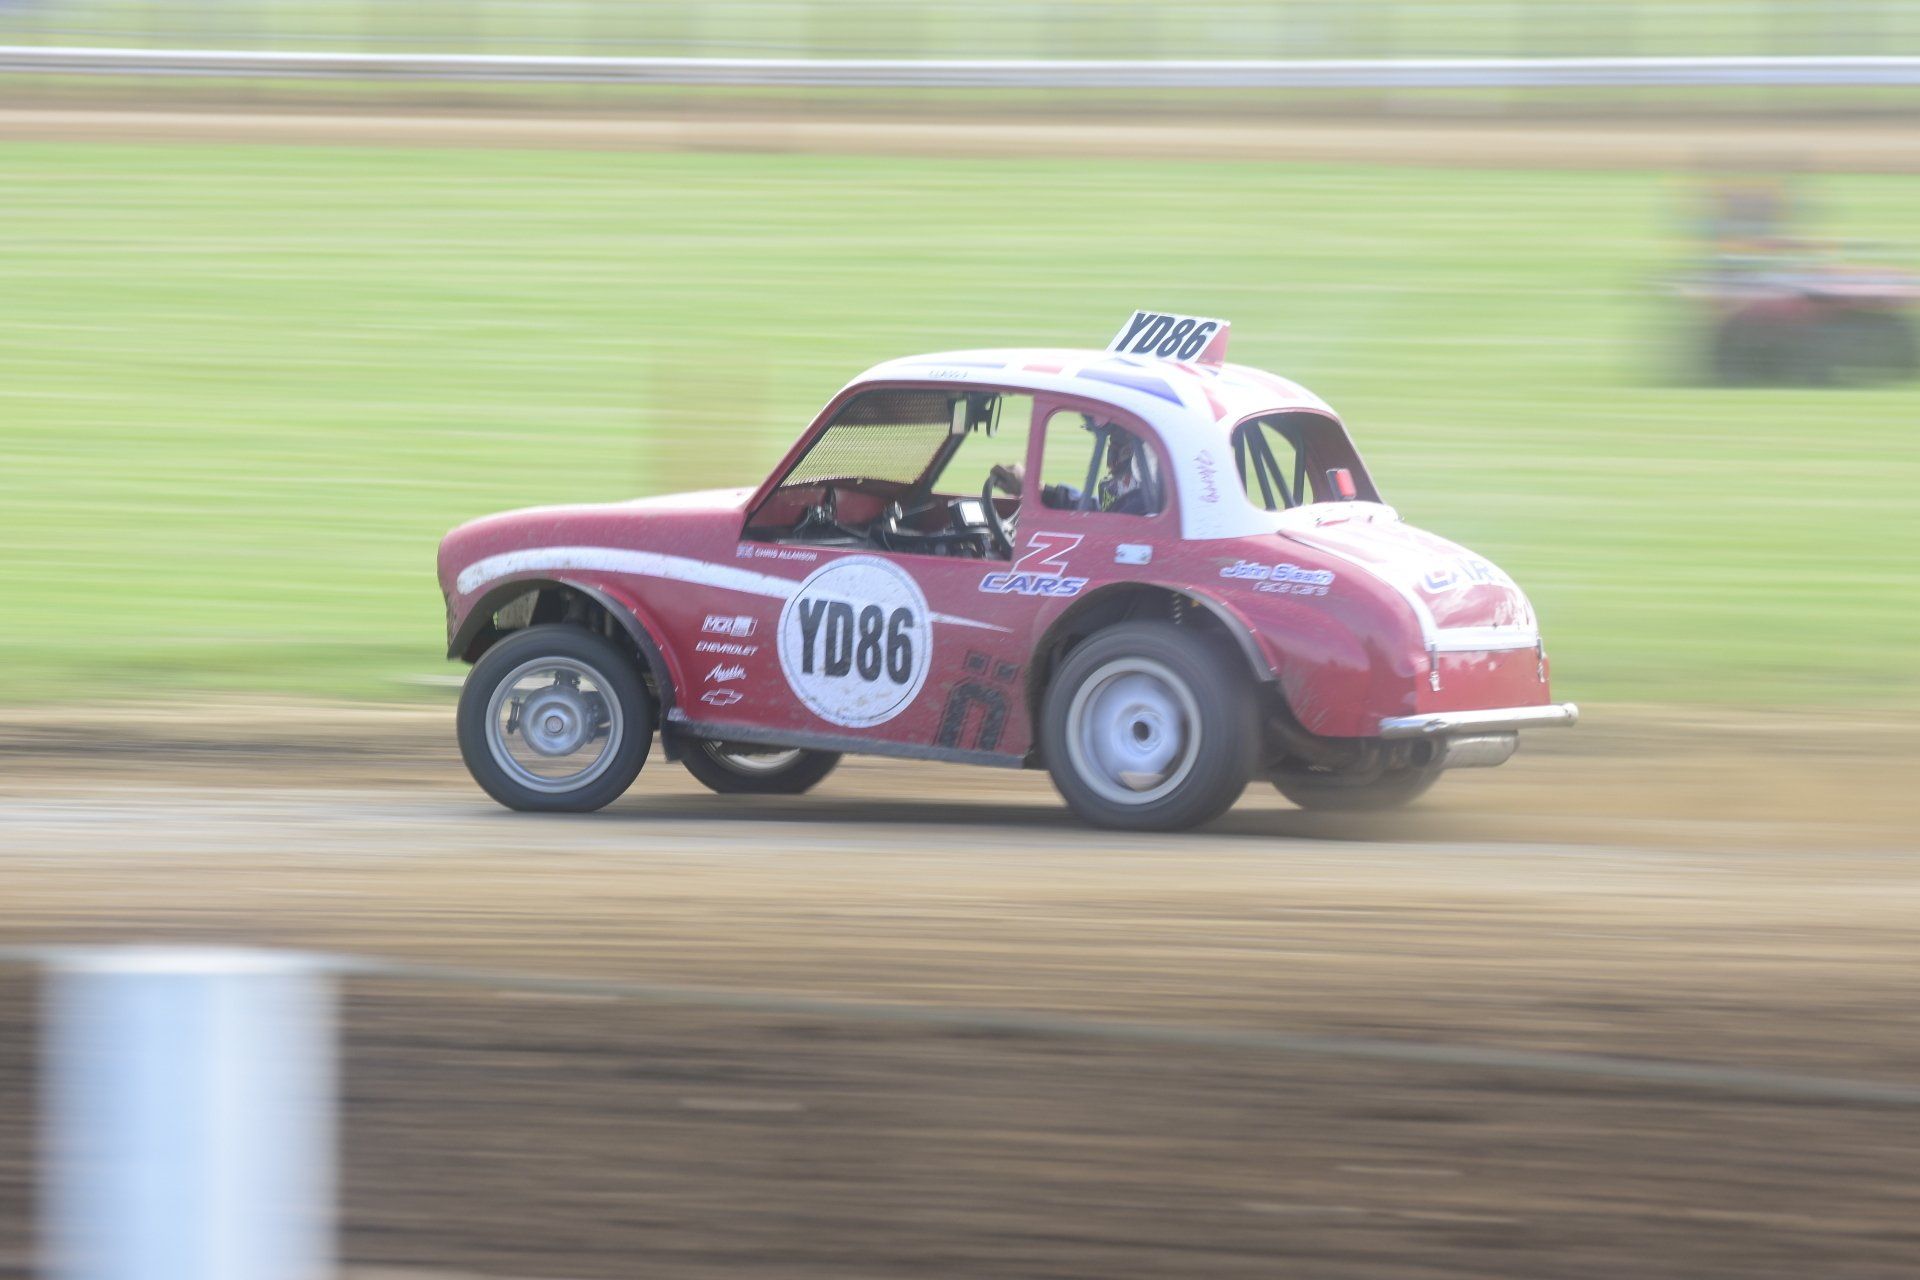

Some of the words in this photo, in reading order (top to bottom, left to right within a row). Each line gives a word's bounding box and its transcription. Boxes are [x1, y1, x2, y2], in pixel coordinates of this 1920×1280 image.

[1114, 312, 1217, 360] YD86
[754, 547, 778, 559] CHRIS
[1010, 531, 1085, 577] Z
[1220, 560, 1272, 580] John
[978, 571, 1089, 597] CARS
[1290, 584, 1330, 596] cars
[696, 640, 758, 656] CHEVROLET
[799, 597, 914, 685] YD86
